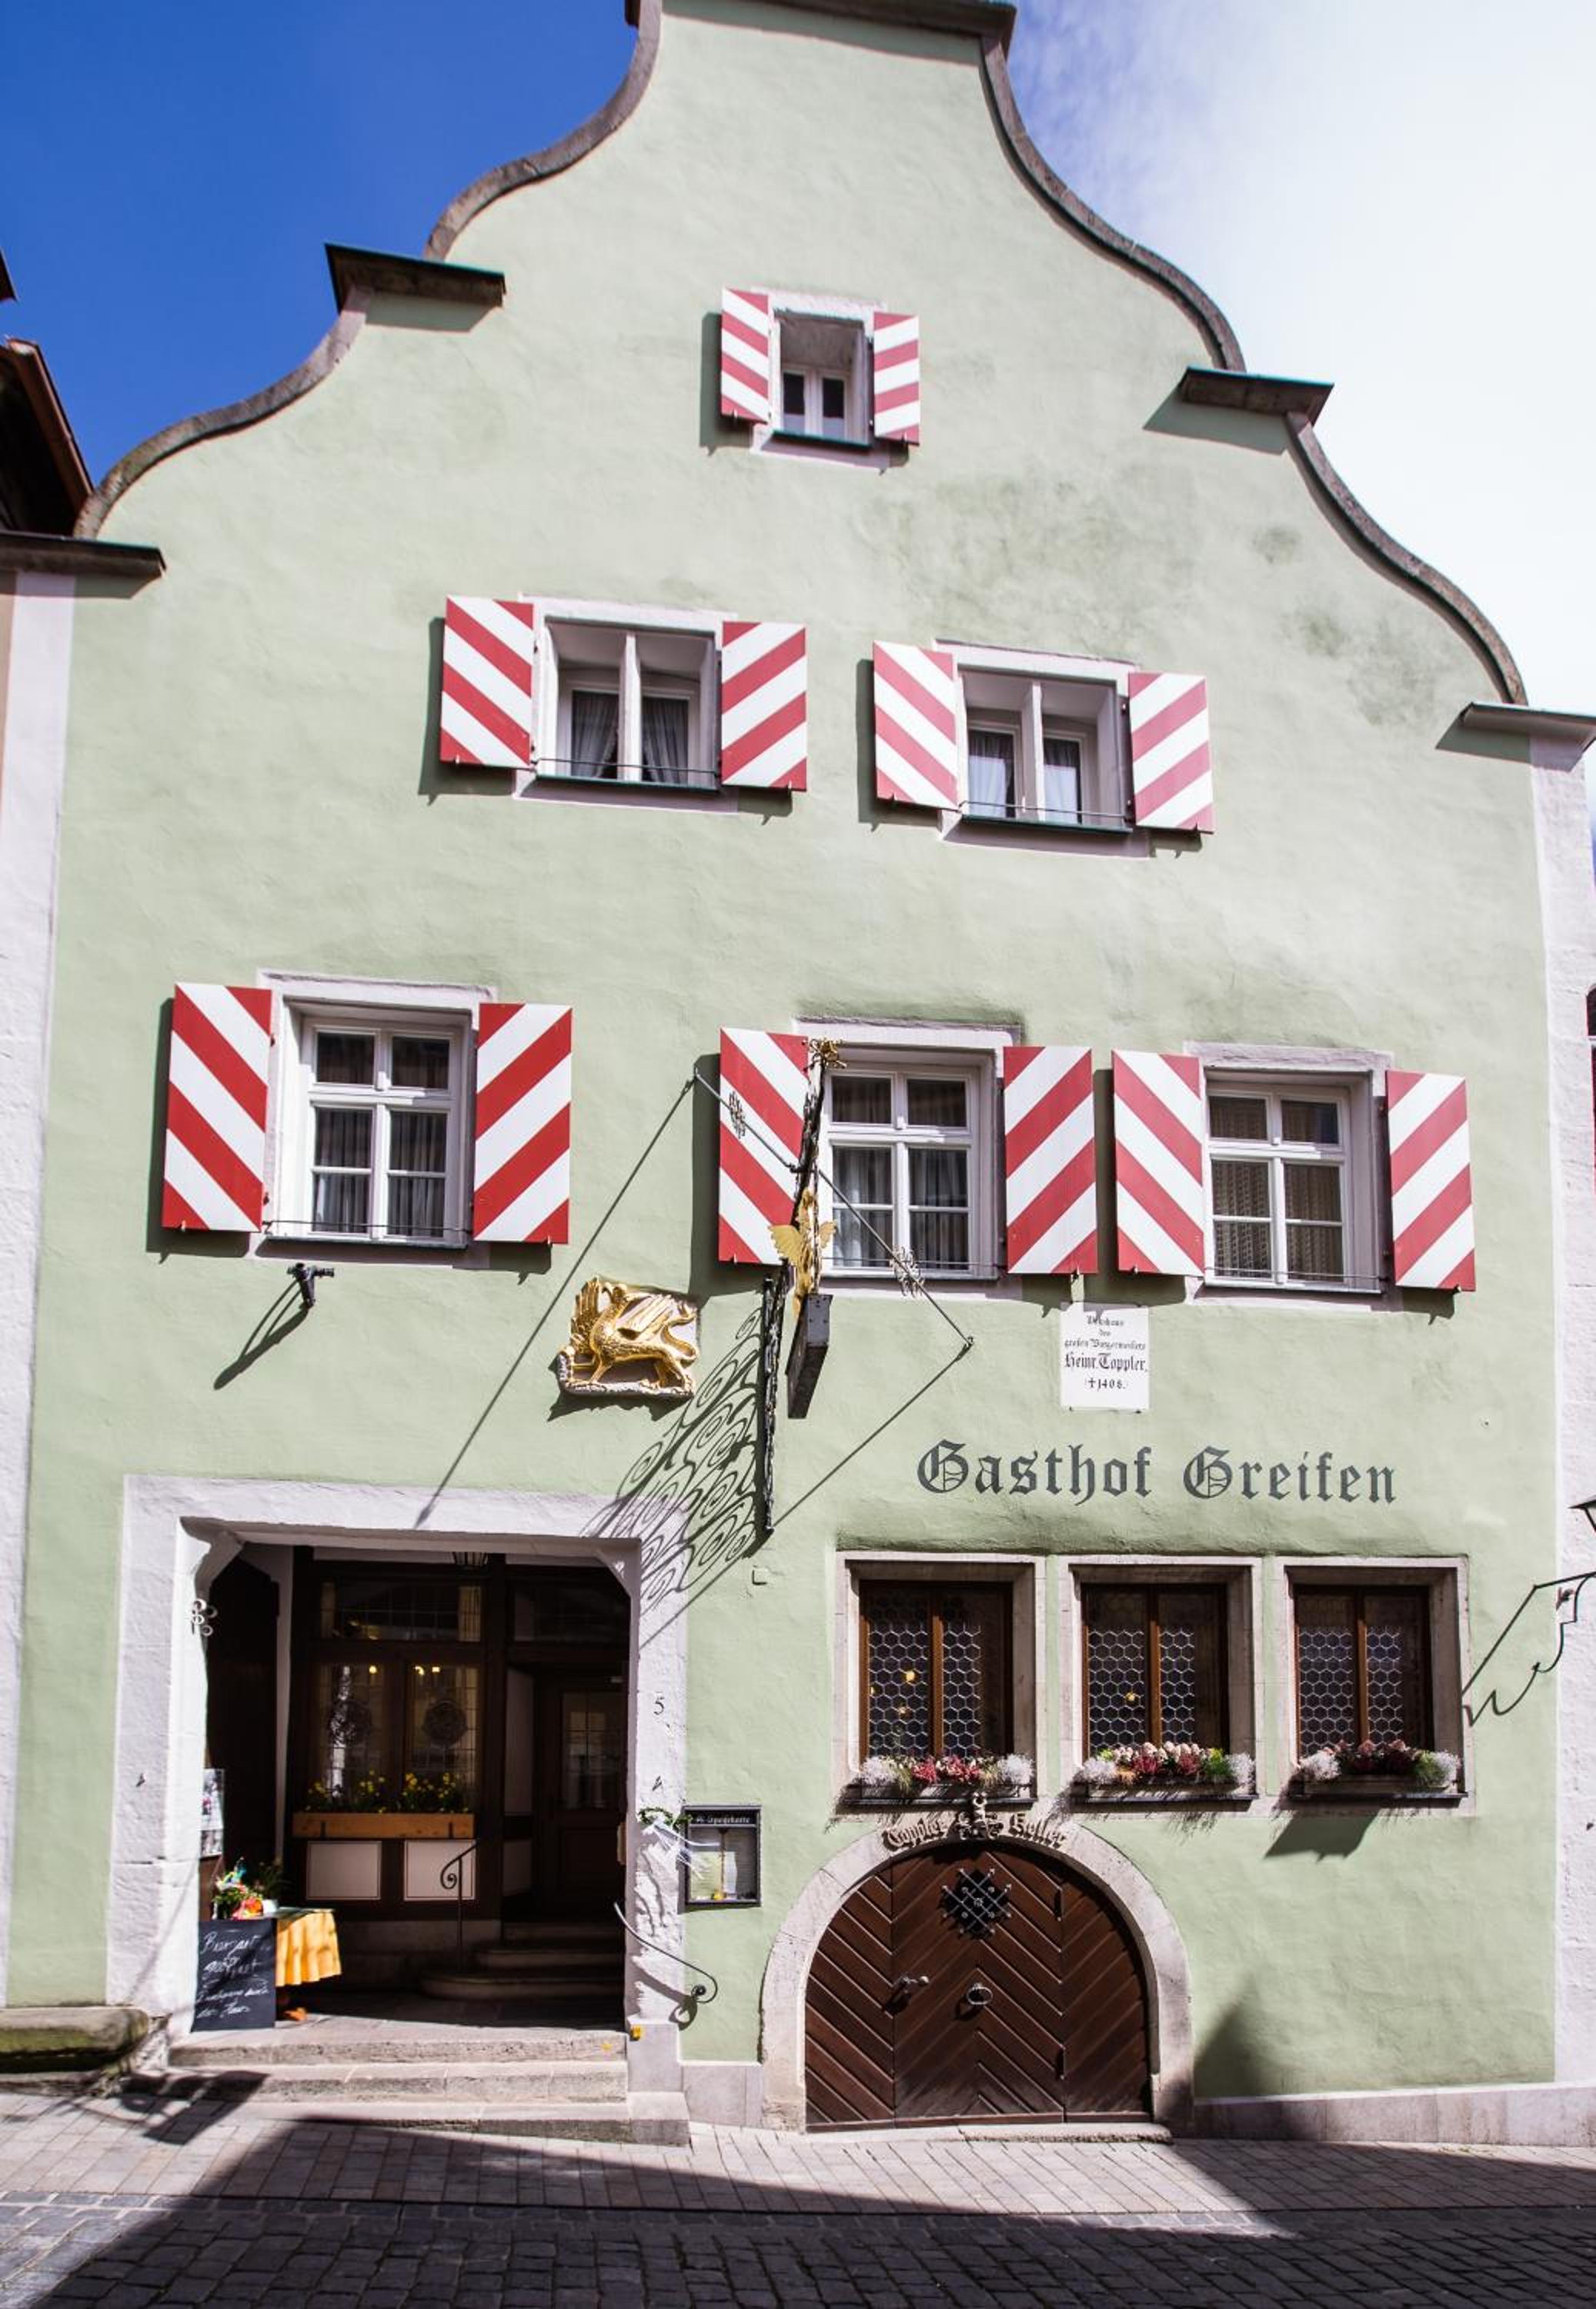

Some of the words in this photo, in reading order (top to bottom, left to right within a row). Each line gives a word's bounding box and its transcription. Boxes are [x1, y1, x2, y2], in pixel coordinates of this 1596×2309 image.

[917, 1439, 1152, 1506] Gasthof
[1183, 1445, 1397, 1504] Greifen
[653, 1696, 665, 1716] 5
[884, 1819, 949, 1850] Toppler
[1009, 1813, 1067, 1849] Keller
